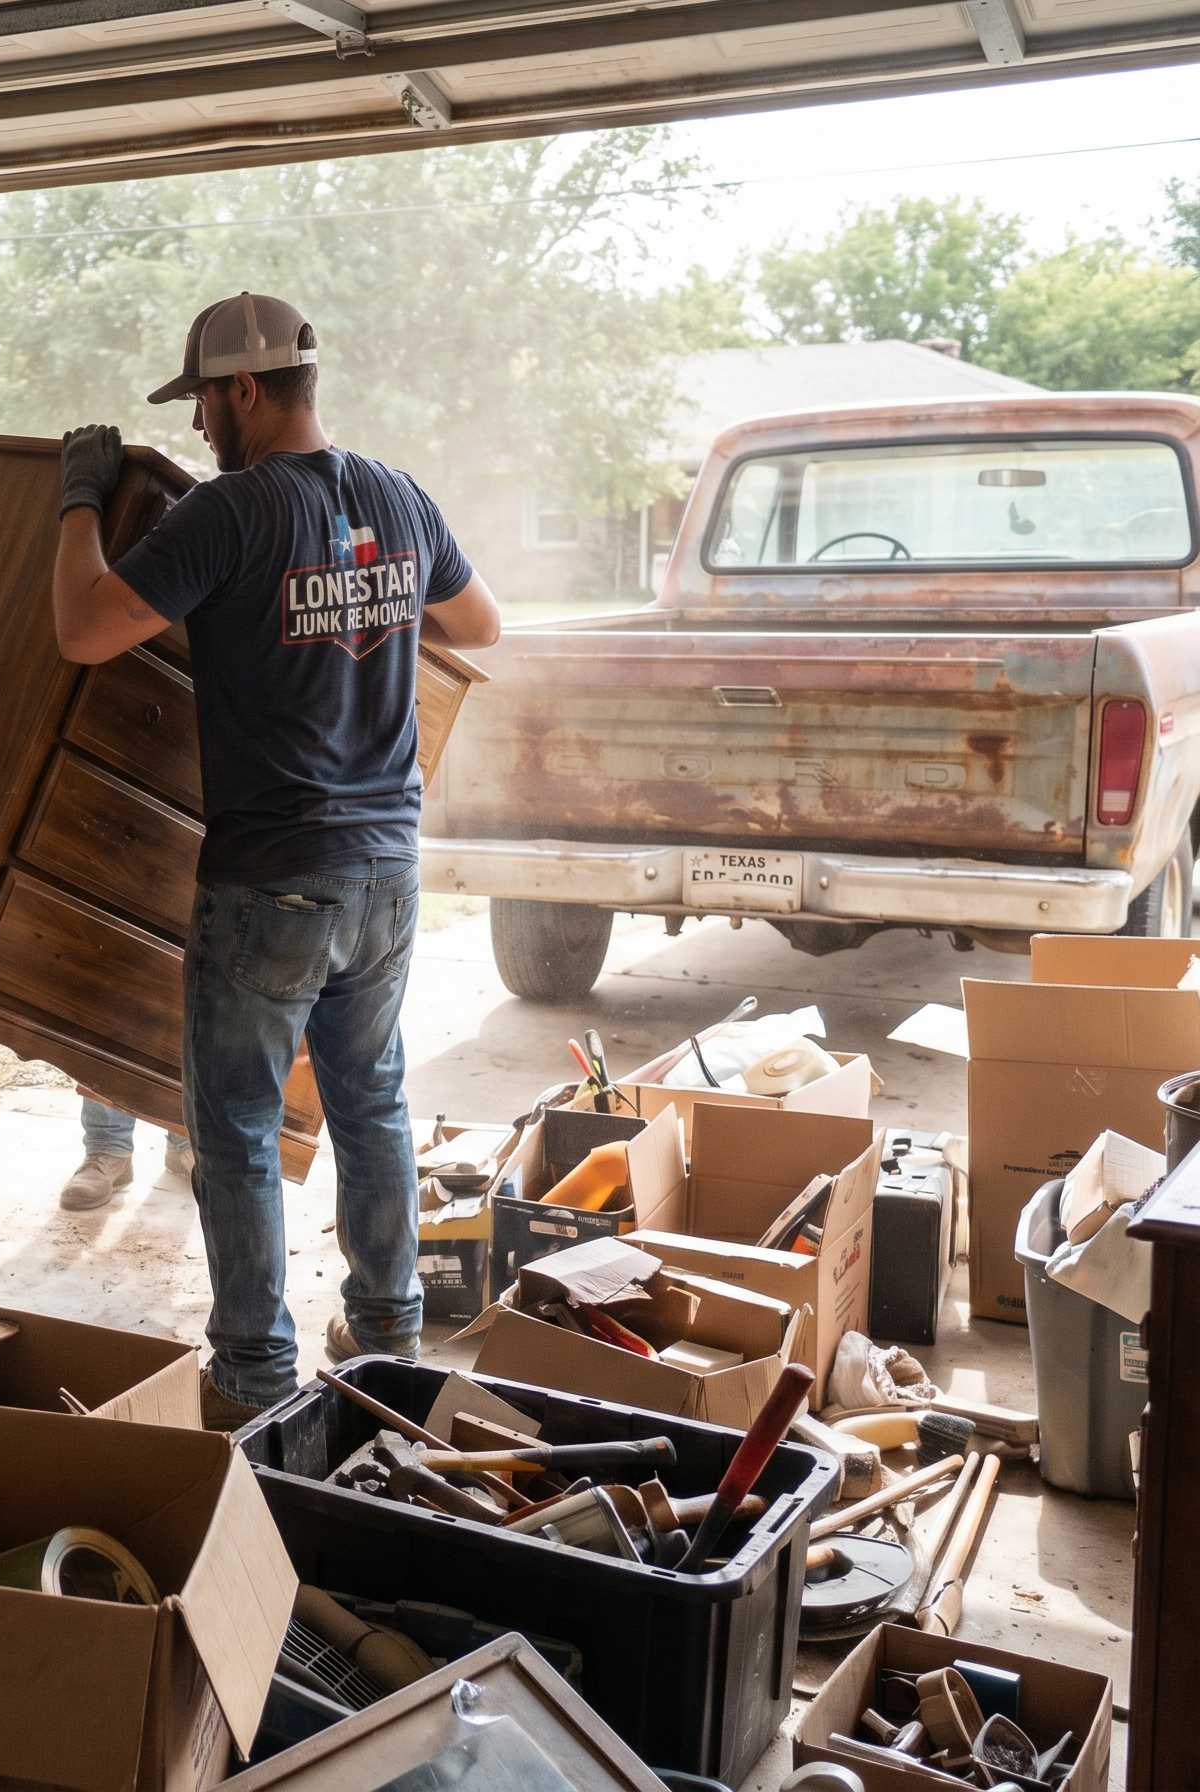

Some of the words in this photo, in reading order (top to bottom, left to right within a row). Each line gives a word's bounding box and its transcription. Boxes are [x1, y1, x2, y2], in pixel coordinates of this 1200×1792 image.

[289, 561, 415, 611] LONESTAR
[289, 610, 343, 637] JUNK
[347, 598, 416, 631] REMOVAL
[719, 854, 766, 868] TEXAS
